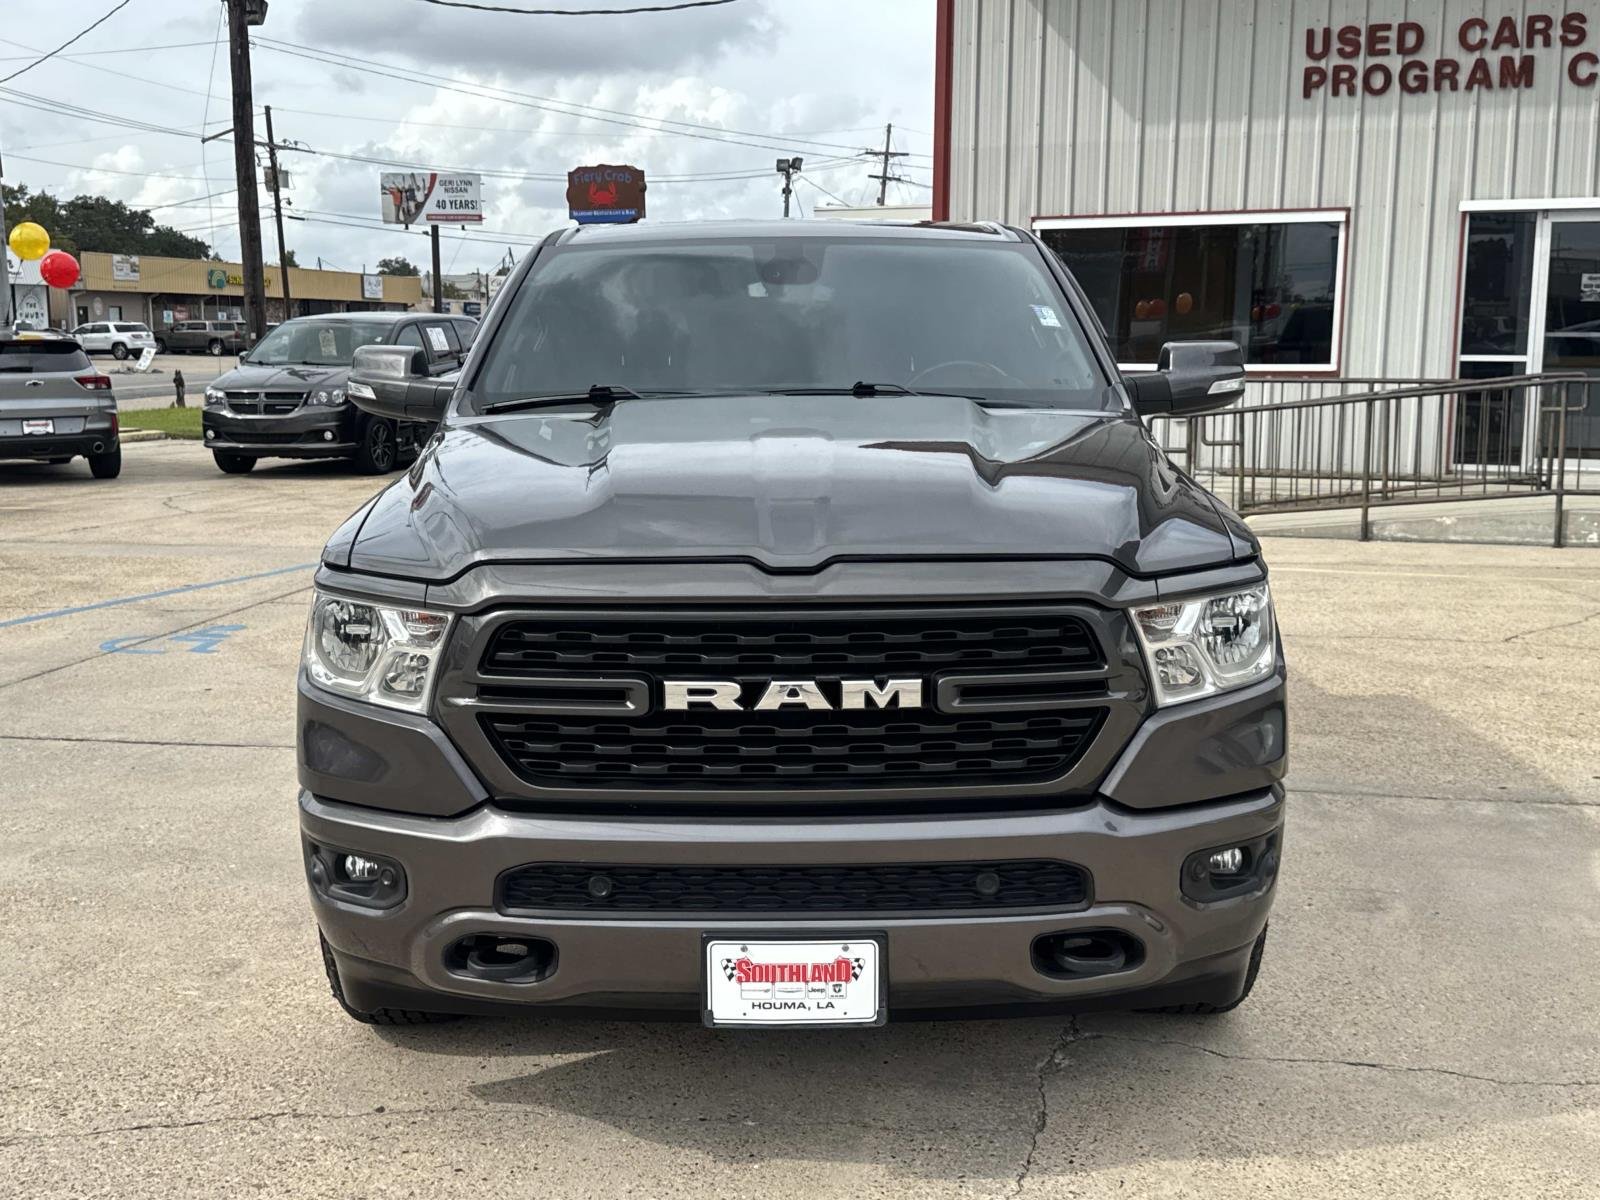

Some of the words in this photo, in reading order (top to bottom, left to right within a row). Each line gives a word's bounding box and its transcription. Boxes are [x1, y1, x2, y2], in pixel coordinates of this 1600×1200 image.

[1305, 22, 1425, 61] USED
[1458, 12, 1587, 52] CARS
[1303, 55, 1535, 99] PROGRAM
[1568, 52, 1600, 87] C
[456, 179, 473, 187] LYNN
[604, 169, 632, 184] Crab
[444, 186, 469, 194] NISSAN
[436, 199, 447, 210] 40
[449, 199, 479, 210] YEARS!
[663, 679, 923, 711] RAM
[736, 957, 852, 984] SOUTHLAND
[751, 1001, 811, 1011] HOUMA,
[816, 1001, 836, 1009] LA
